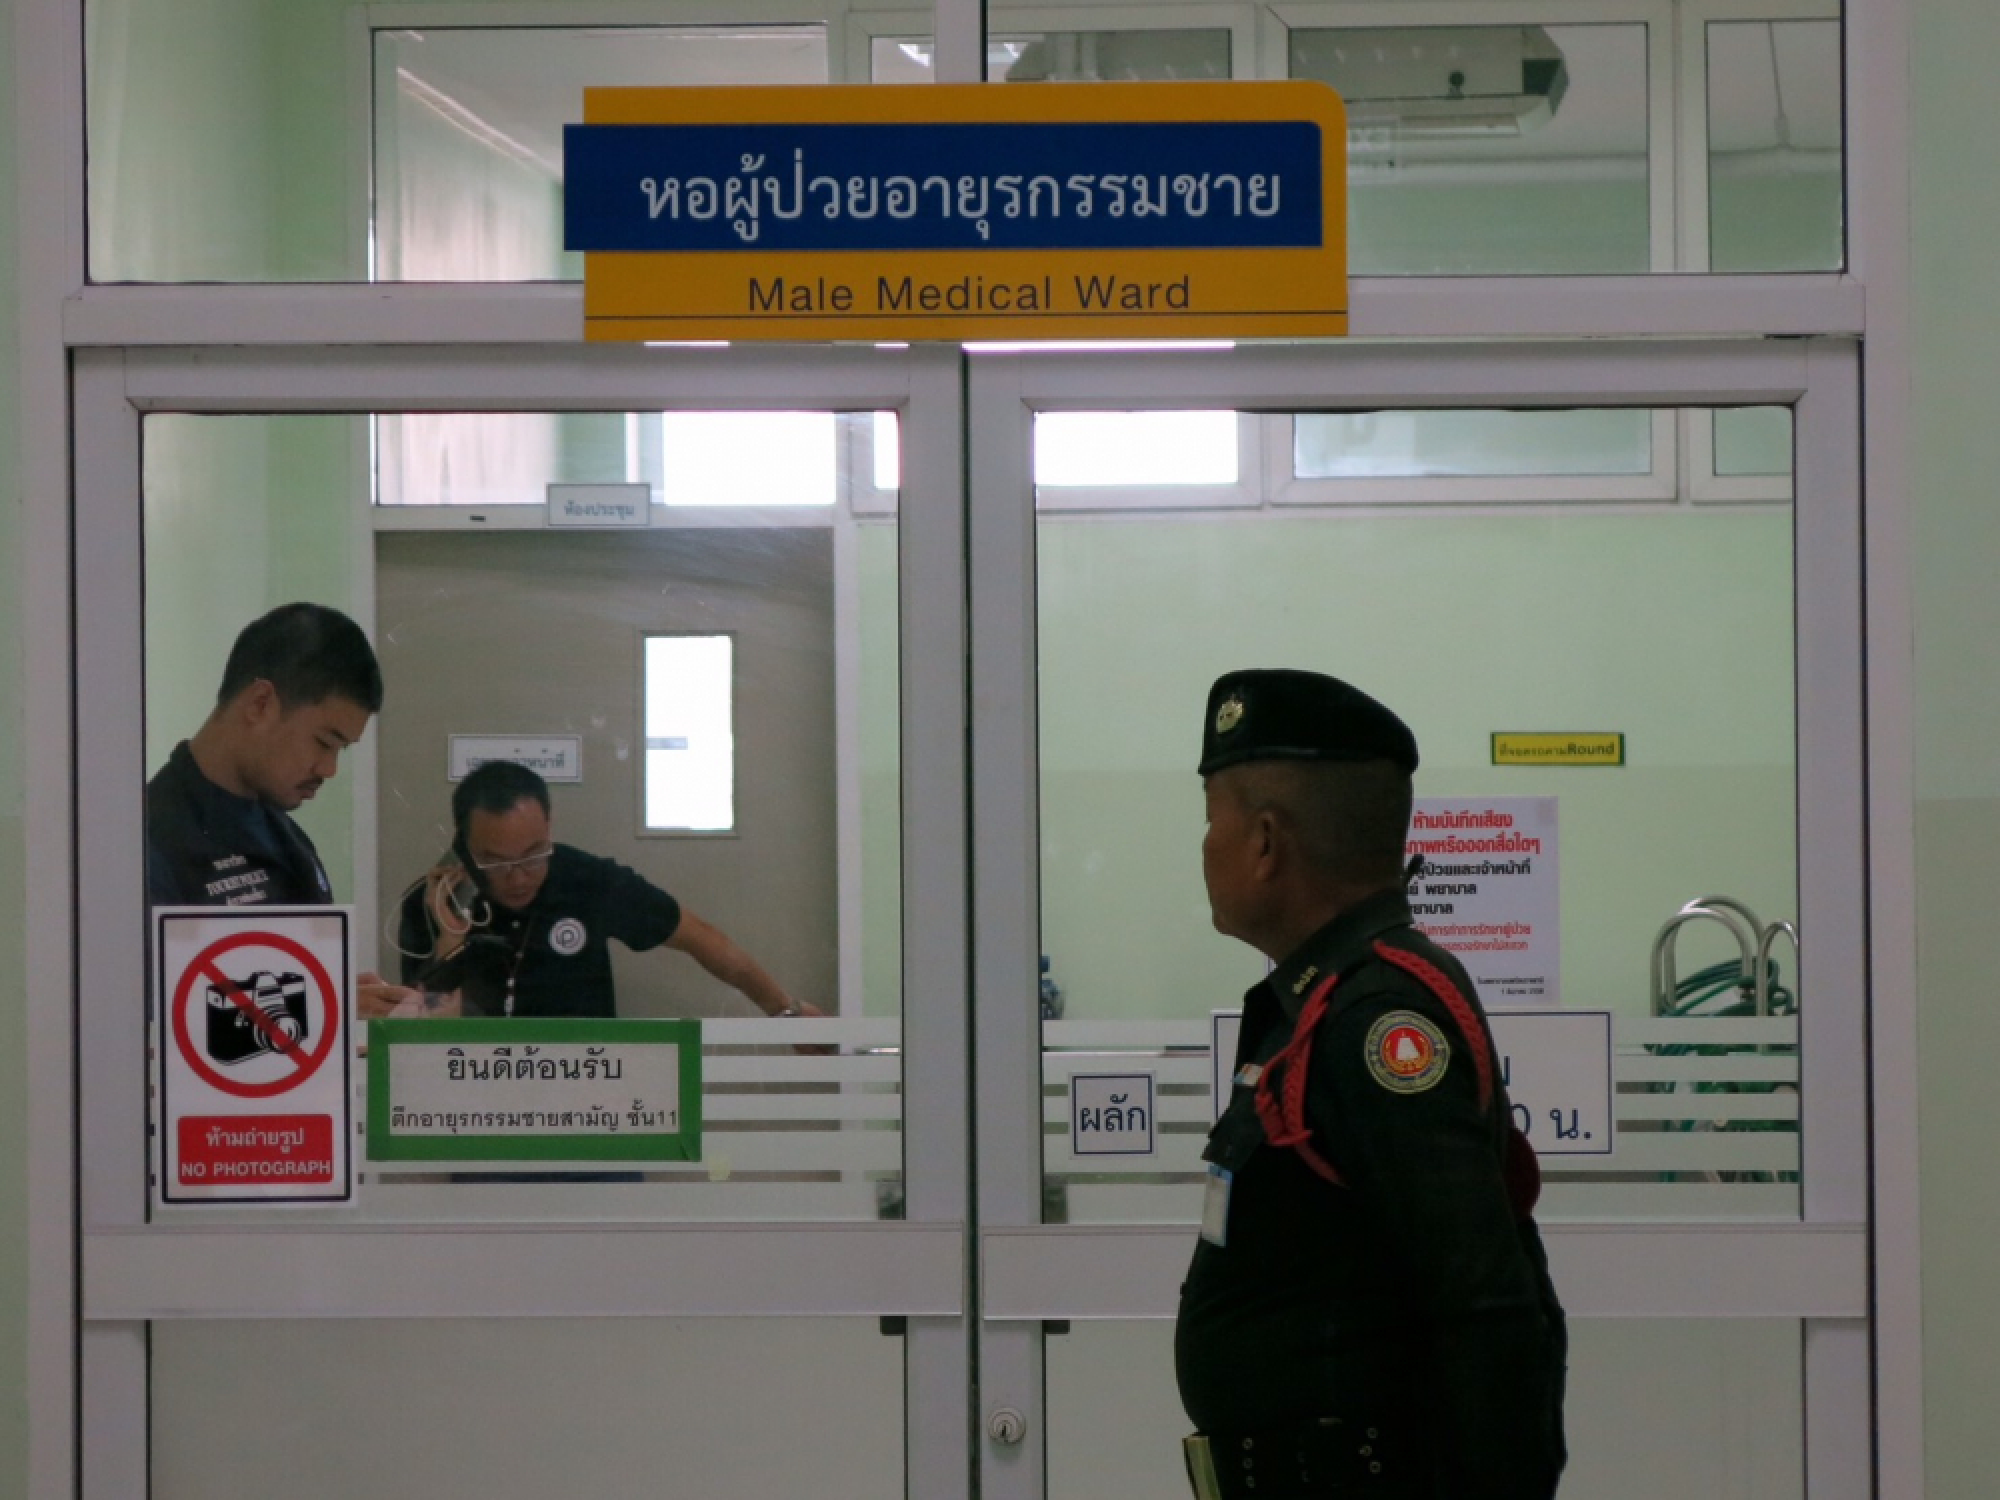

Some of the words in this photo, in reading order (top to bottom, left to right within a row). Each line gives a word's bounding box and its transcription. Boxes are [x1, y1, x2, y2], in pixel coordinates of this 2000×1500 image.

[639, 147, 1281, 241] หอผู้ป่วยอายุรกรรมชาย
[748, 276, 853, 312] Male
[877, 275, 1051, 311] Medical
[1074, 275, 1191, 310] Ward
[1413, 810, 1513, 829] ห้ามบันทึกเสียง
[446, 1046, 623, 1080] ยินดีต้อนรับ
[391, 1104, 619, 1134] ตึกอายุรกรรมชายสามัญ
[626, 1099, 678, 1130] ชั้น11
[1080, 1093, 1146, 1132] ผลัก
[1549, 1108, 1592, 1140] น.
[204, 1125, 305, 1155] ห้ามถ่ายรูป
[181, 1161, 207, 1177] NO
[213, 1160, 331, 1177] PHOTOGRAPH
